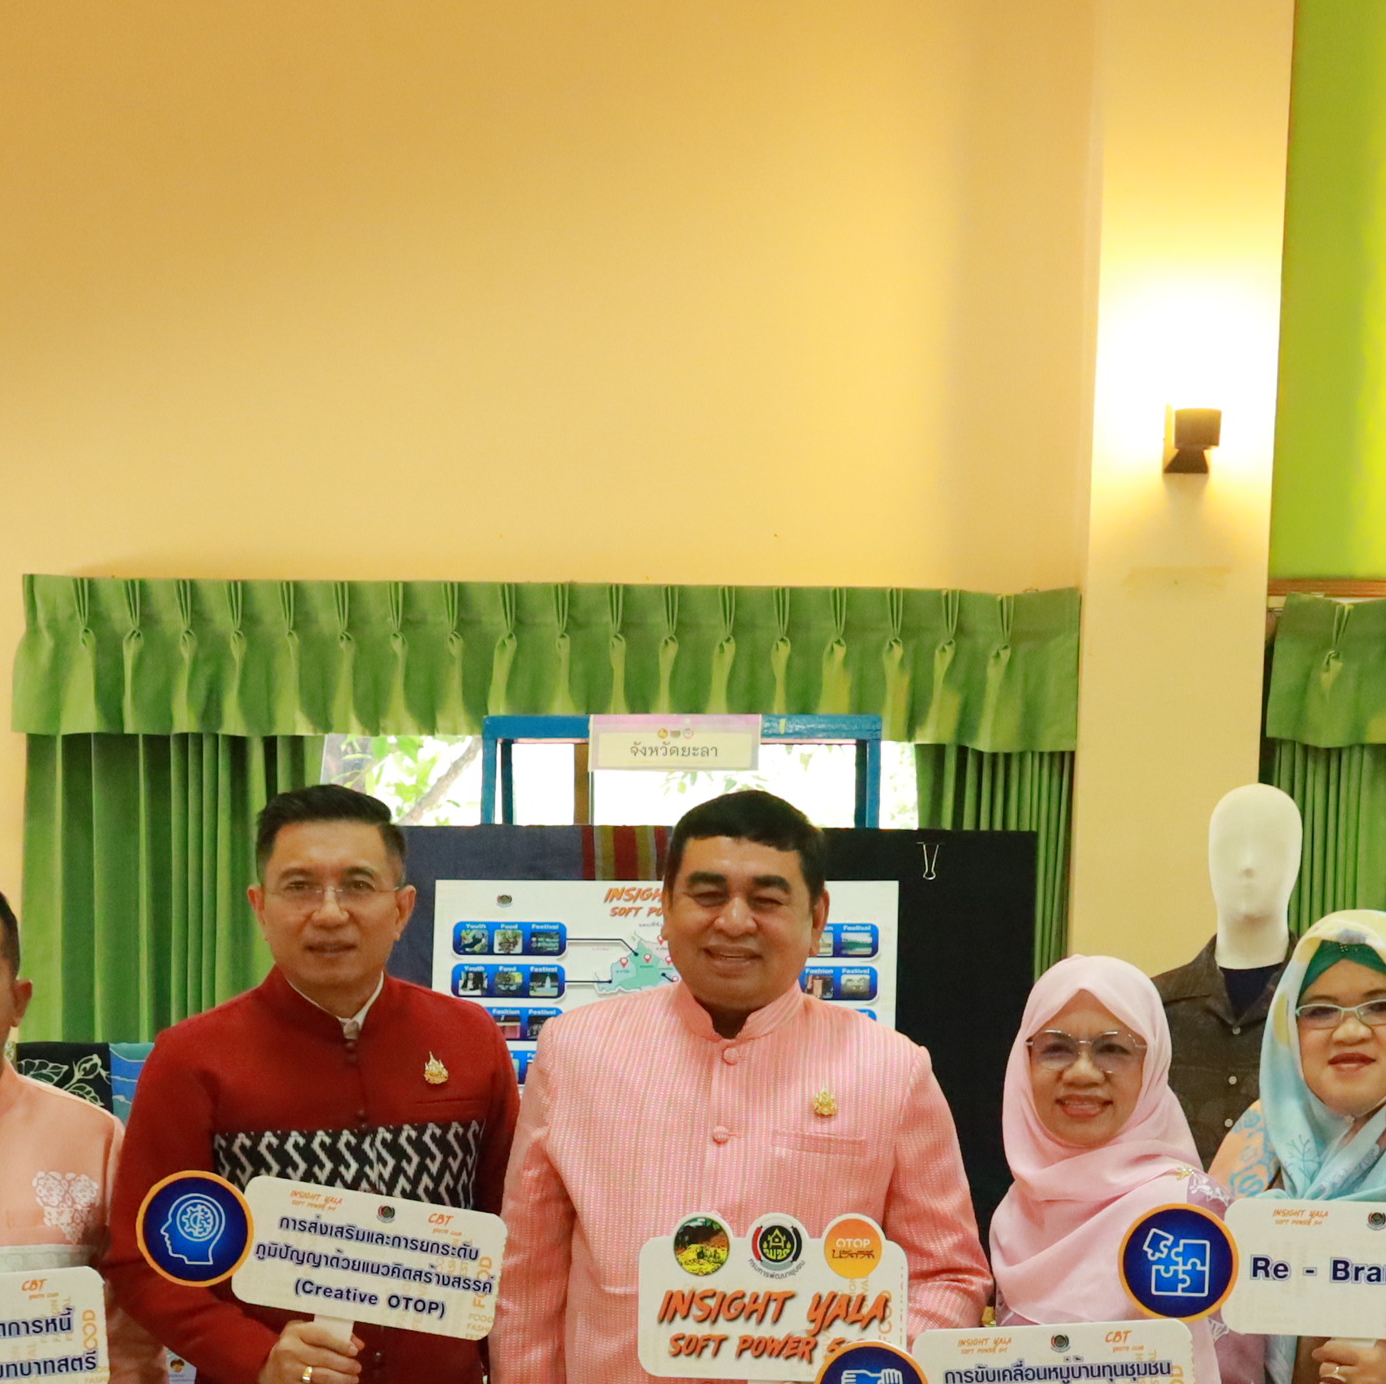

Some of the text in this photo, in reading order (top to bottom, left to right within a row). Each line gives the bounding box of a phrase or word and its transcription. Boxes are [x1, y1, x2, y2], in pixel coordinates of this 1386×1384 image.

[629, 741, 719, 758] จังหวัดยะลา
[609, 906, 643, 918] SOFT
[428, 1212, 454, 1226] CBT
[279, 1214, 480, 1262] การส่งเสริมและการยกระดับ
[835, 1238, 871, 1249] OTOP
[255, 1241, 496, 1295] ภูมิปัญญาด้วยแนวคิดสร้างสรรค์
[1250, 1254, 1292, 1281] Re
[21, 1279, 48, 1292] CBT
[294, 1278, 446, 1320] (Creative OTOP)
[657, 1288, 891, 1337] INSIGHT YALA
[668, 1332, 729, 1360] SOFT
[735, 1332, 819, 1365] POWER
[1104, 1330, 1132, 1344] CBT
[944, 1356, 1173, 1384] การขับเคลื่อนหมู่บ้านทุนชุมชน
